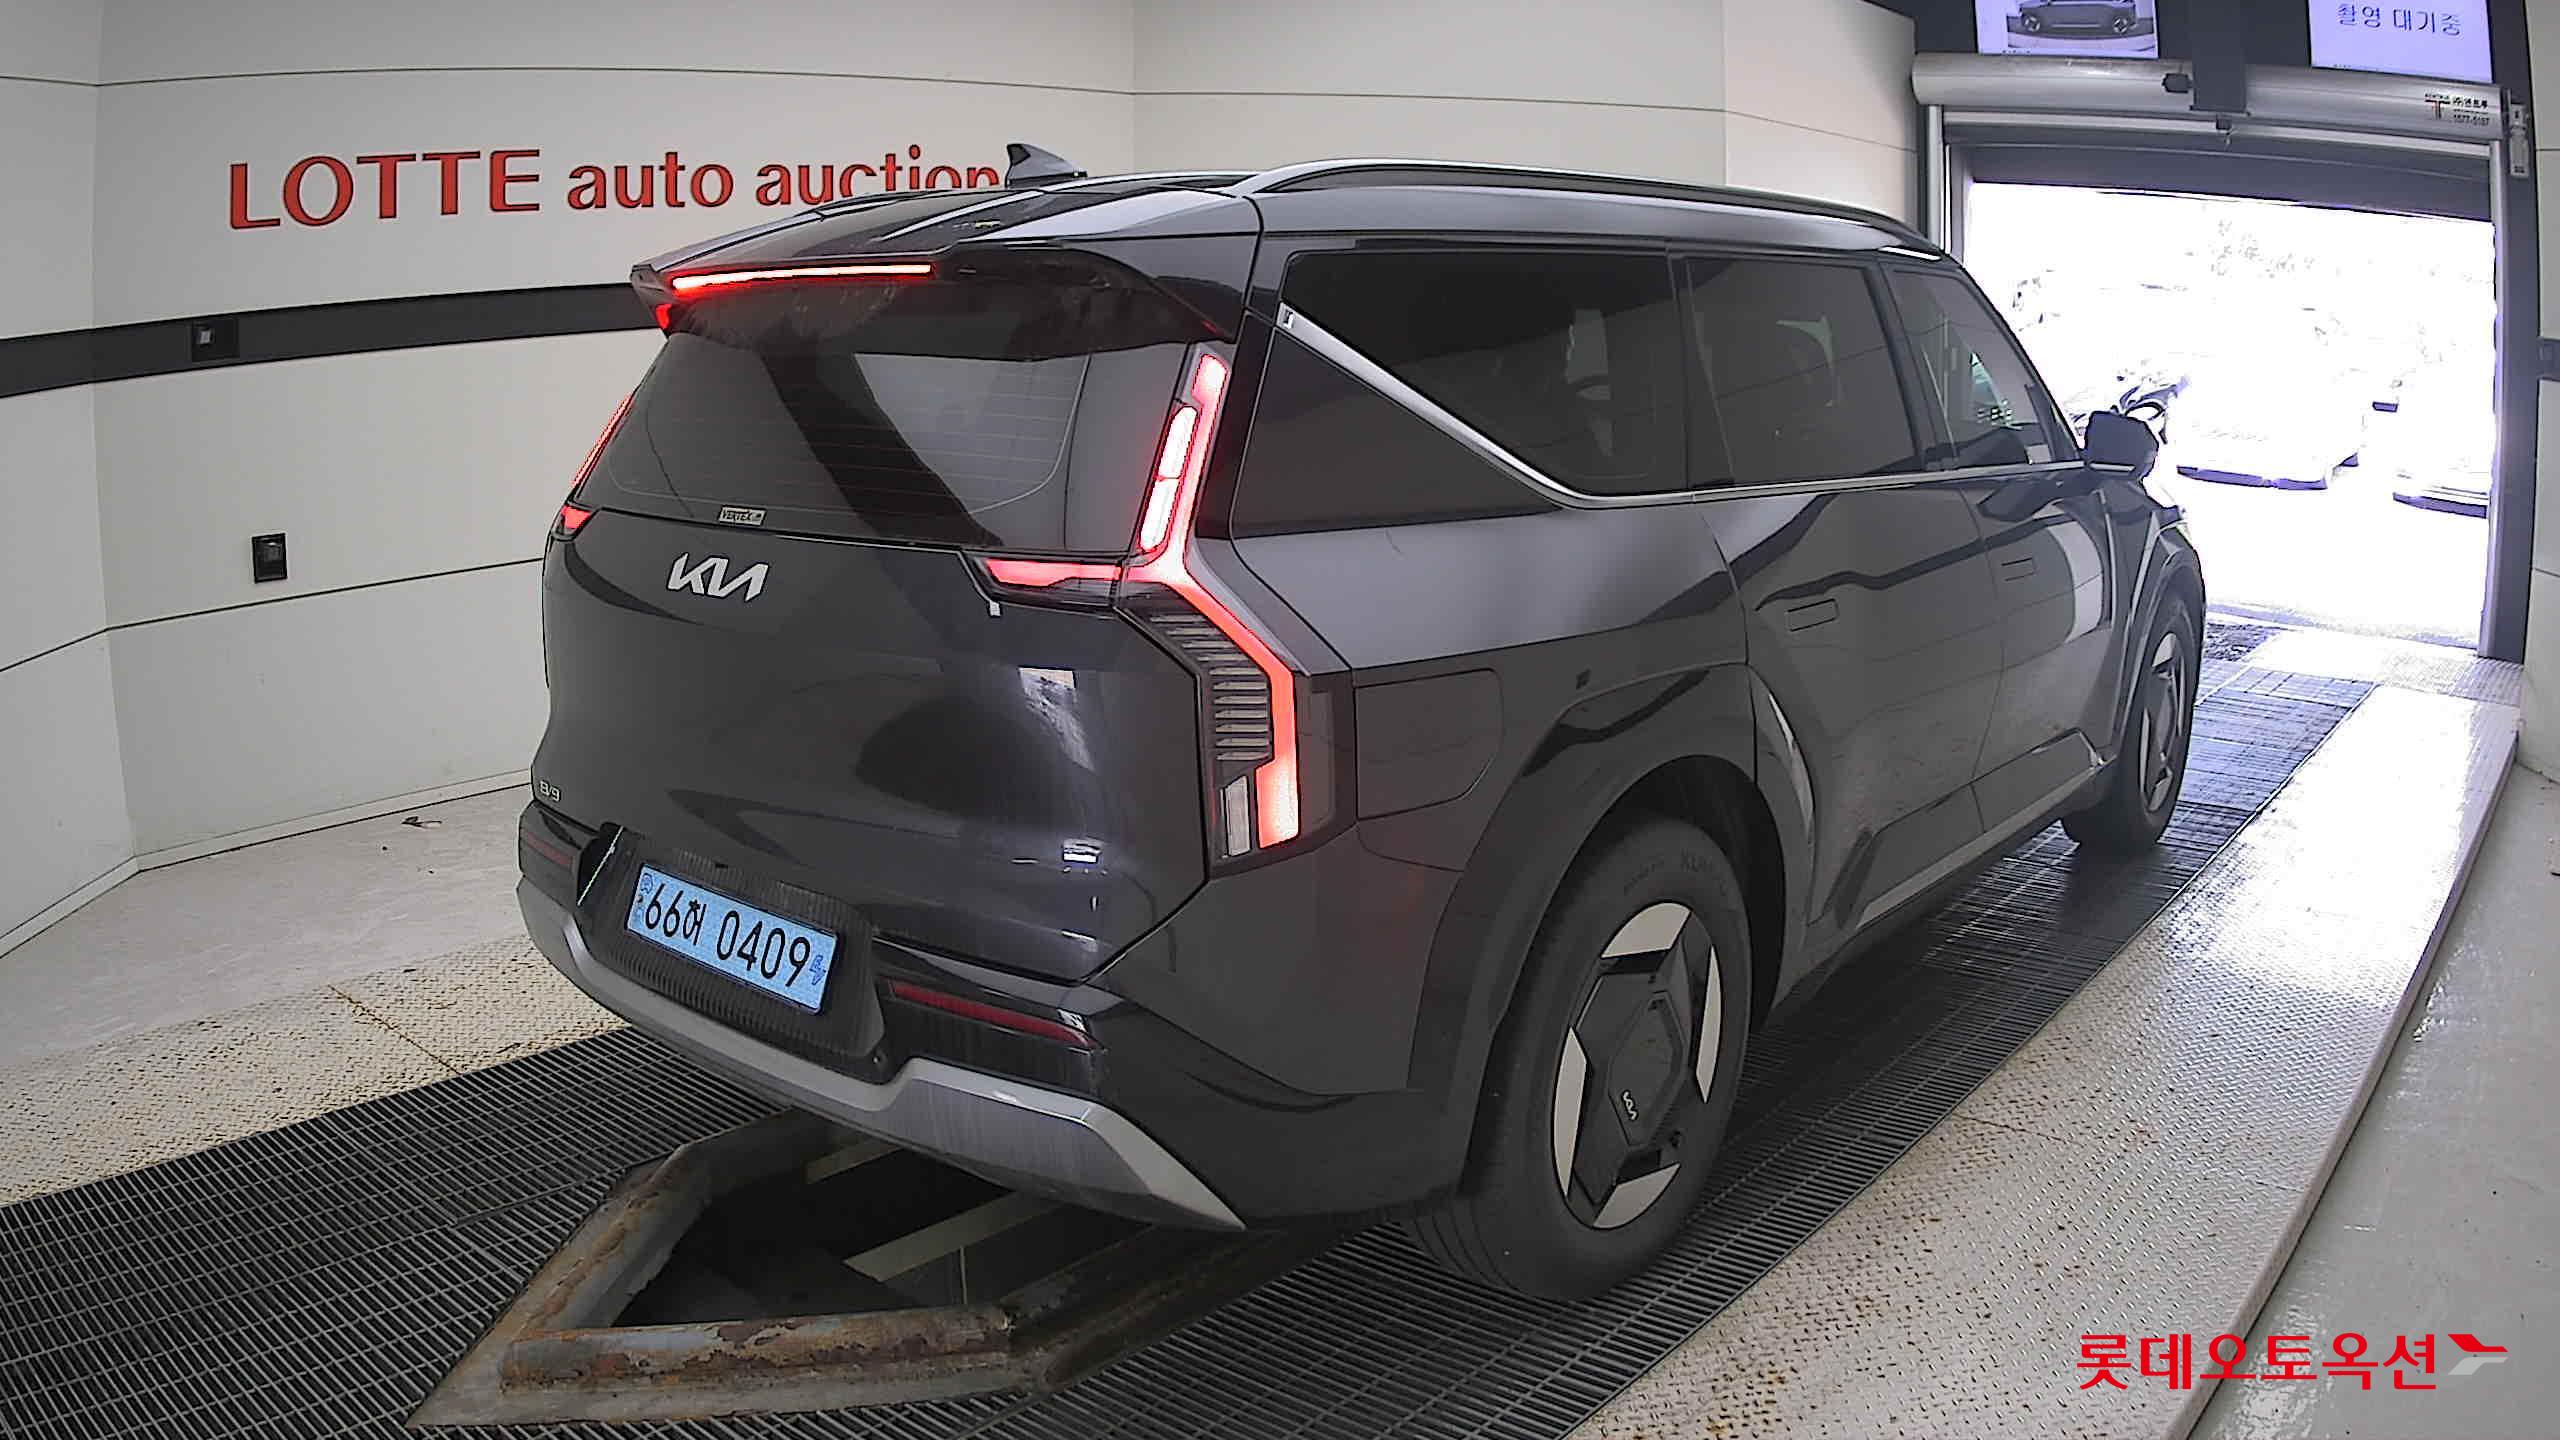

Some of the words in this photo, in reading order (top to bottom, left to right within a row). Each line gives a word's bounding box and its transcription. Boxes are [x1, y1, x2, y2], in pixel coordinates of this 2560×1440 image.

[2392, 7, 2461, 37] 대기중
[229, 148, 541, 230] LOTTE
[567, 151, 735, 210] auto
[666, 551, 770, 603] KIA
[645, 882, 708, 946] 66허
[715, 910, 812, 988] 0409
